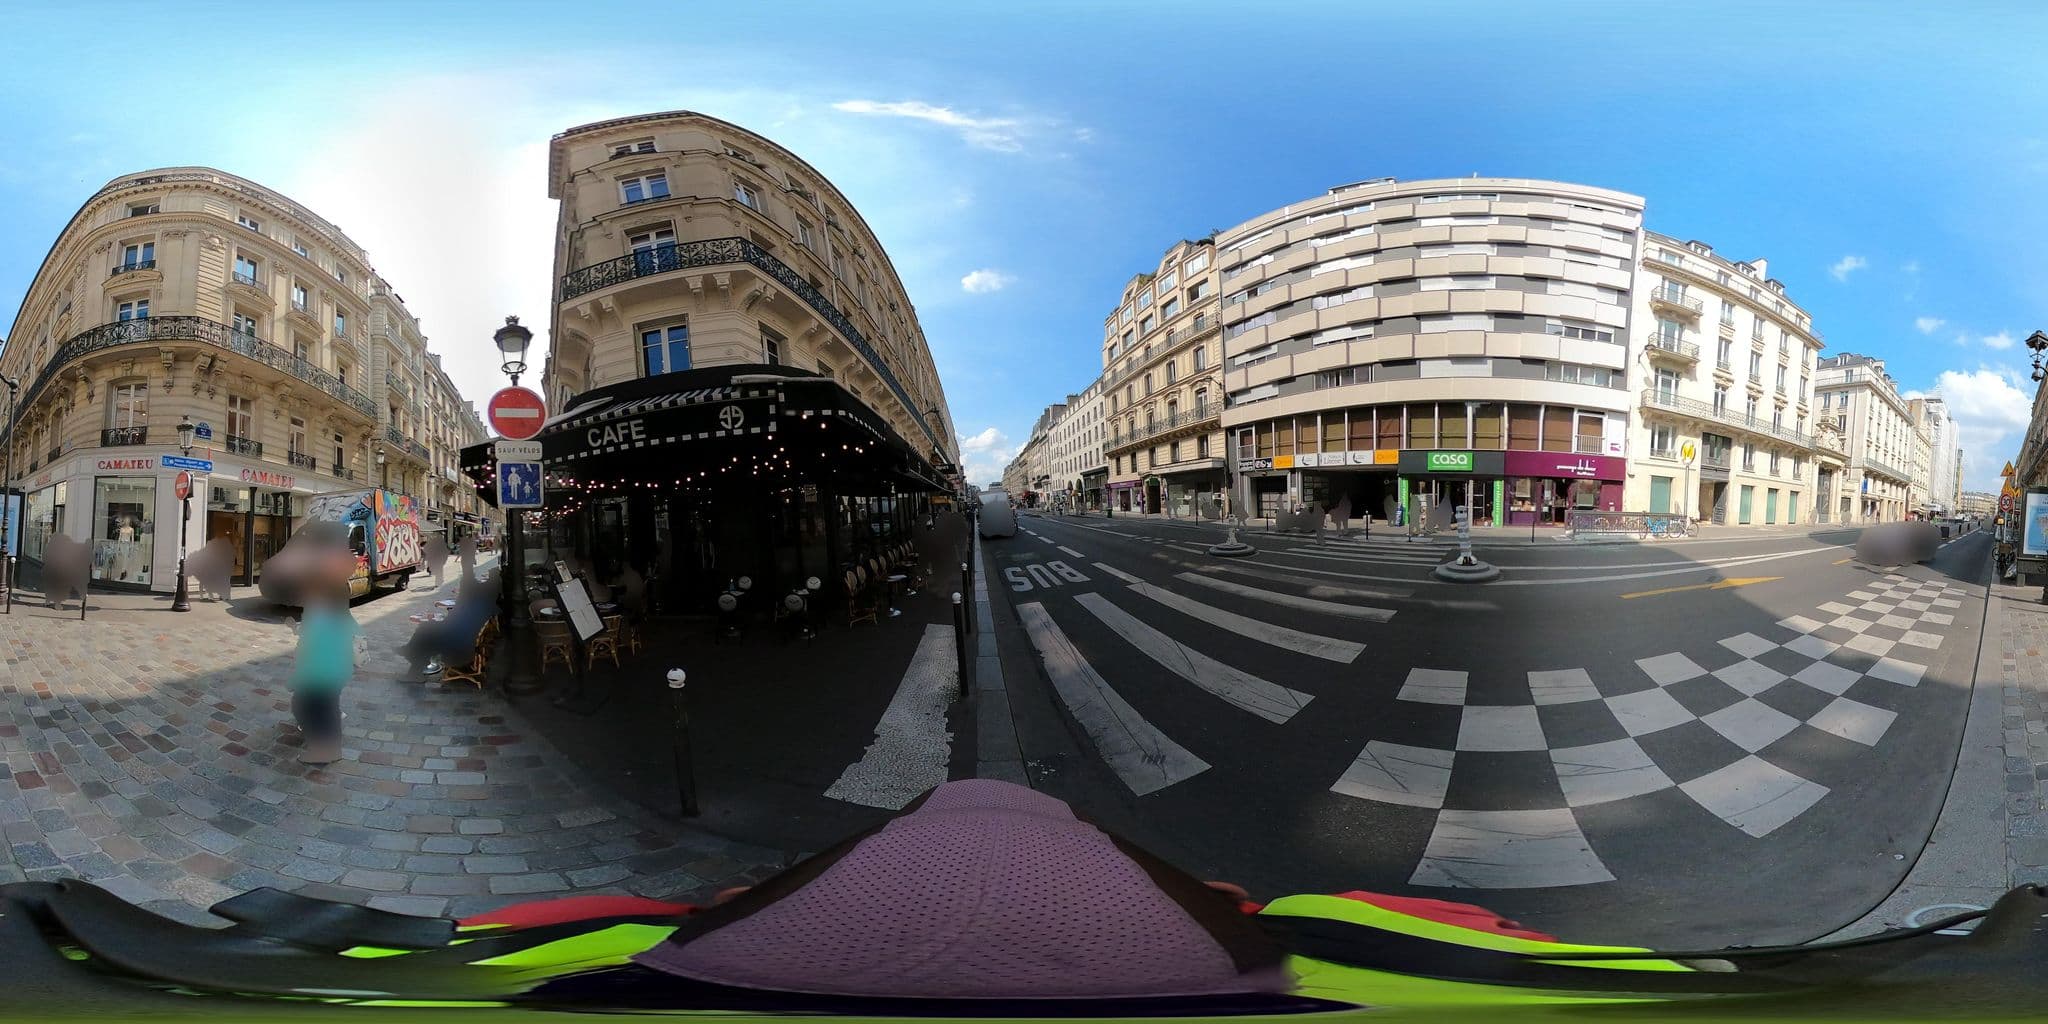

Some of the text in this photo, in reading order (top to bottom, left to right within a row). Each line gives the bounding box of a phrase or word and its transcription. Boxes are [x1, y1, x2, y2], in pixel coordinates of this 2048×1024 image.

[587, 419, 647, 448] CAFE
[1432, 454, 1468, 465] casa
[1004, 560, 1091, 592] BUS
